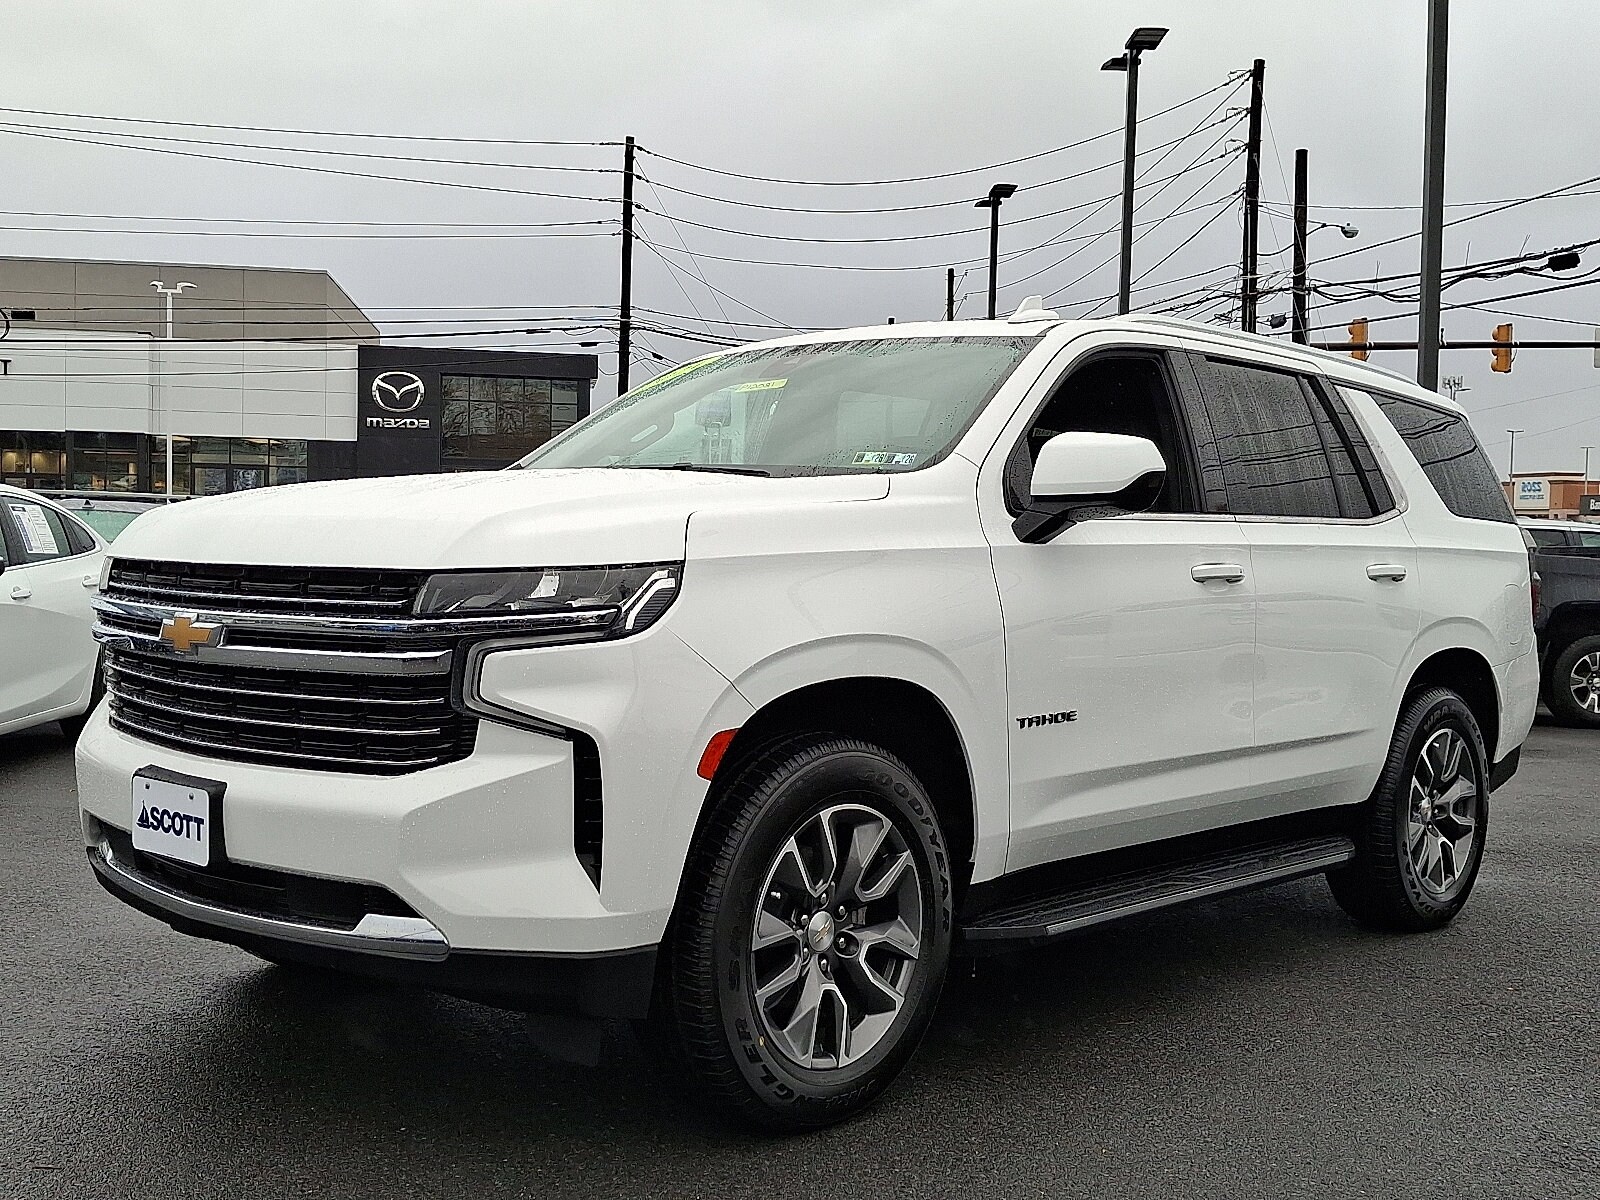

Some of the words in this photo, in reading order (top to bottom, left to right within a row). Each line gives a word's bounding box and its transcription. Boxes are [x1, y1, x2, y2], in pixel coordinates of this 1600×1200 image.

[366, 417, 430, 429] mazda
[1016, 710, 1078, 729] TAHOE
[149, 806, 205, 842] SCOTT
